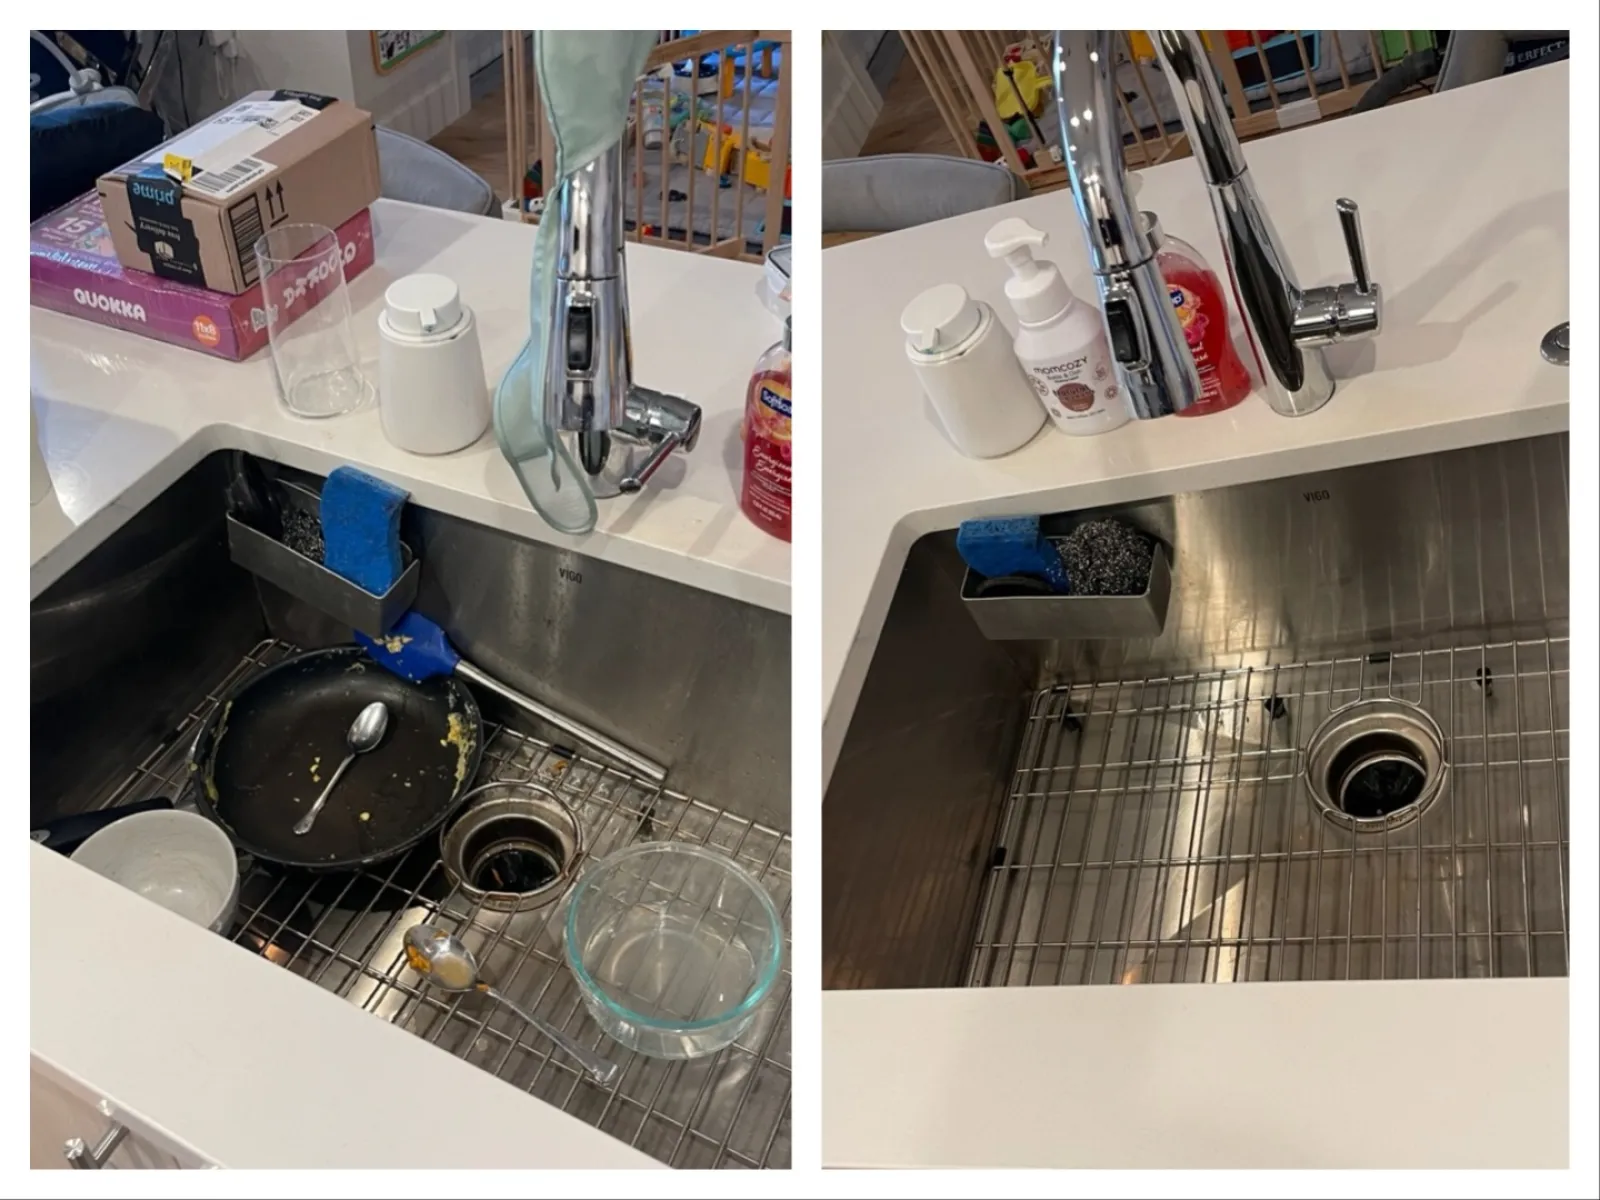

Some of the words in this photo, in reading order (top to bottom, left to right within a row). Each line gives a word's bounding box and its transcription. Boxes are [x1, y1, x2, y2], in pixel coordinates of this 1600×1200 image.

[132, 182, 175, 206] prime
[57, 217, 95, 233] 15
[73, 287, 147, 323] QUOKKA
[1302, 489, 1331, 503] VIGO
[559, 567, 582, 584] VIGO
